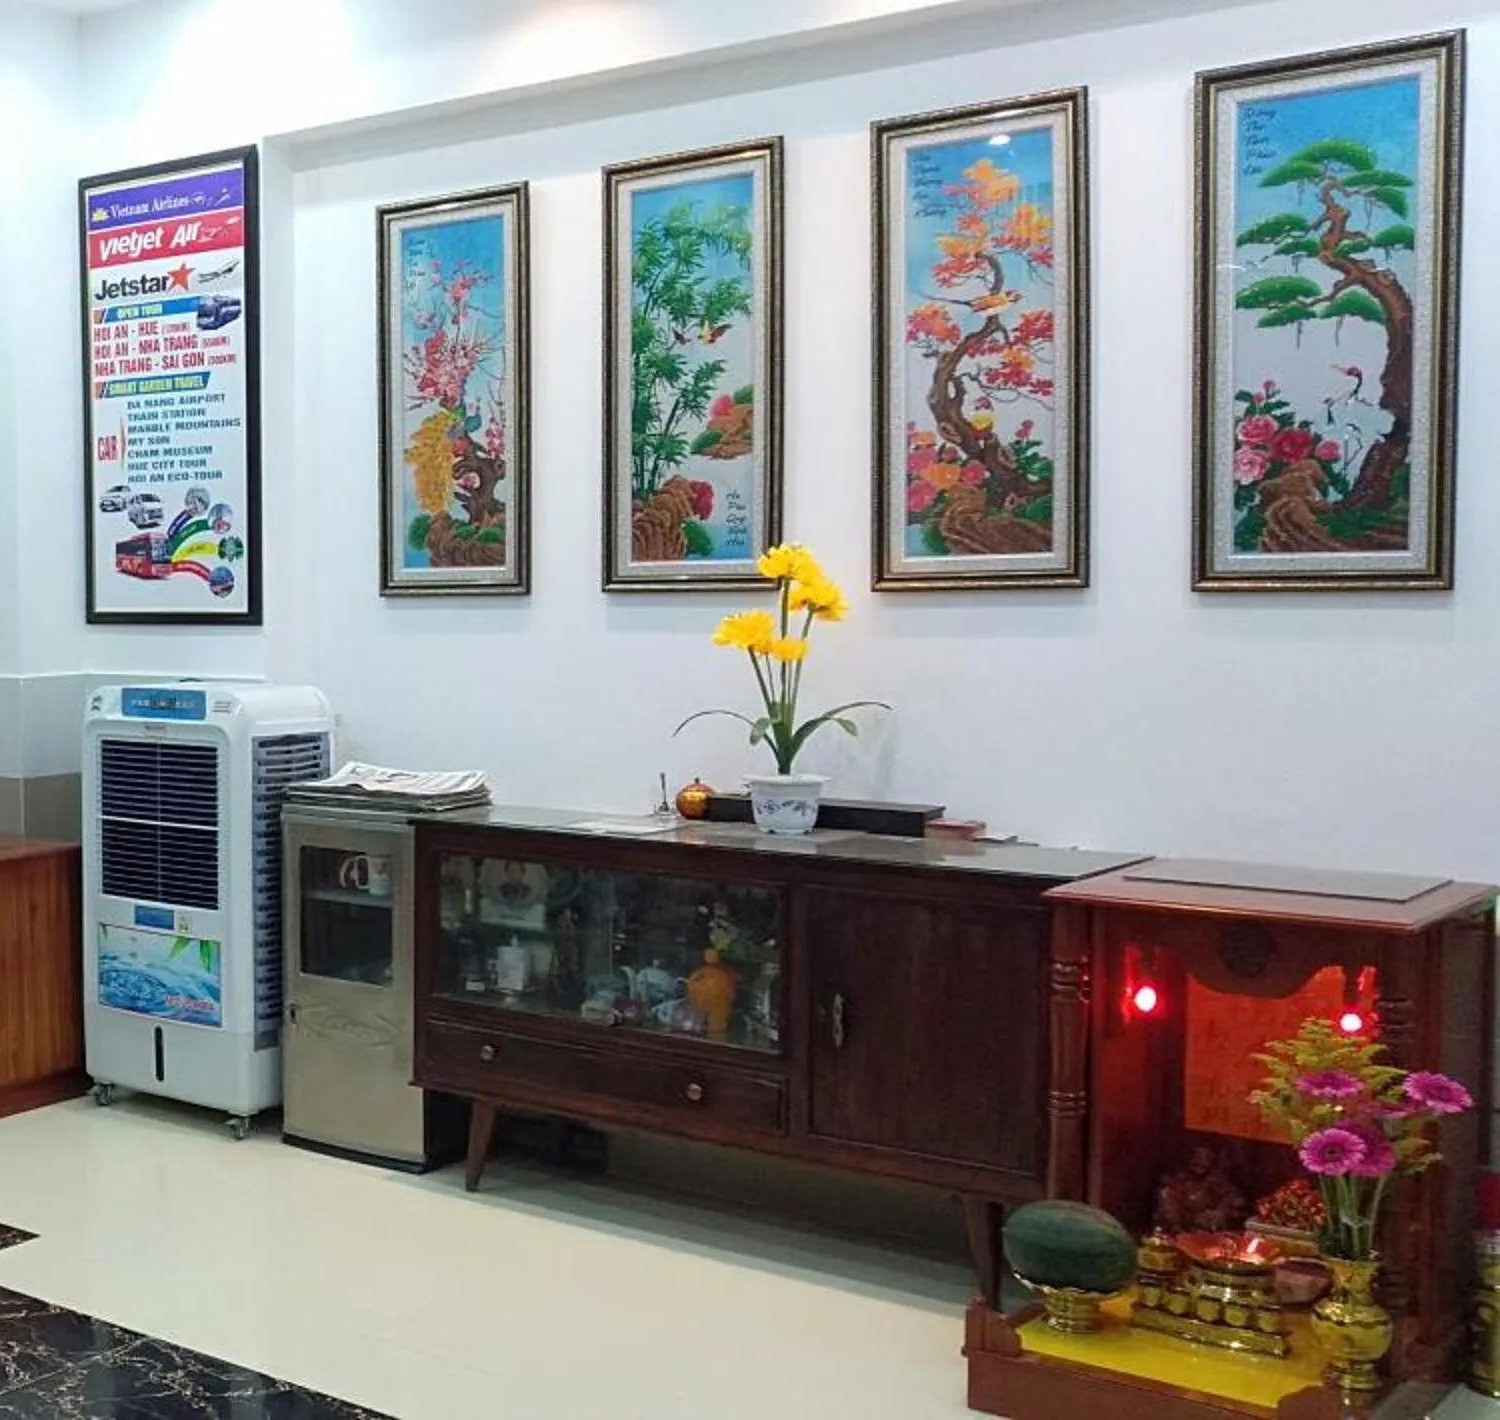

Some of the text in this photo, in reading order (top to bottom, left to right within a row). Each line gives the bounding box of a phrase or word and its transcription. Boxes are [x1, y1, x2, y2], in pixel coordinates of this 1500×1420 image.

[109, 195, 191, 219] Vietnam Airlines
[169, 220, 203, 250] Air
[93, 273, 170, 301] Jetstar
[138, 321, 160, 337] HUE
[138, 338, 161, 355] NHA
[162, 334, 199, 352] TRANG
[94, 360, 117, 378] NHA
[117, 357, 153, 376] TRANG
[161, 354, 181, 370] SAI
[182, 351, 206, 368] GON
[127, 393, 226, 411] DA NANG AIRPORT
[127, 407, 207, 422] TRAIN STATION
[127, 417, 242, 434] MARBLE MOUNTAINS
[127, 436, 145, 446] MY
[127, 445, 214, 460] CHAM MUSEUM
[127, 458, 208, 471] HUE CITY TOUR
[148, 472, 166, 483] AN
[166, 469, 224, 482] ECO-TOUR
